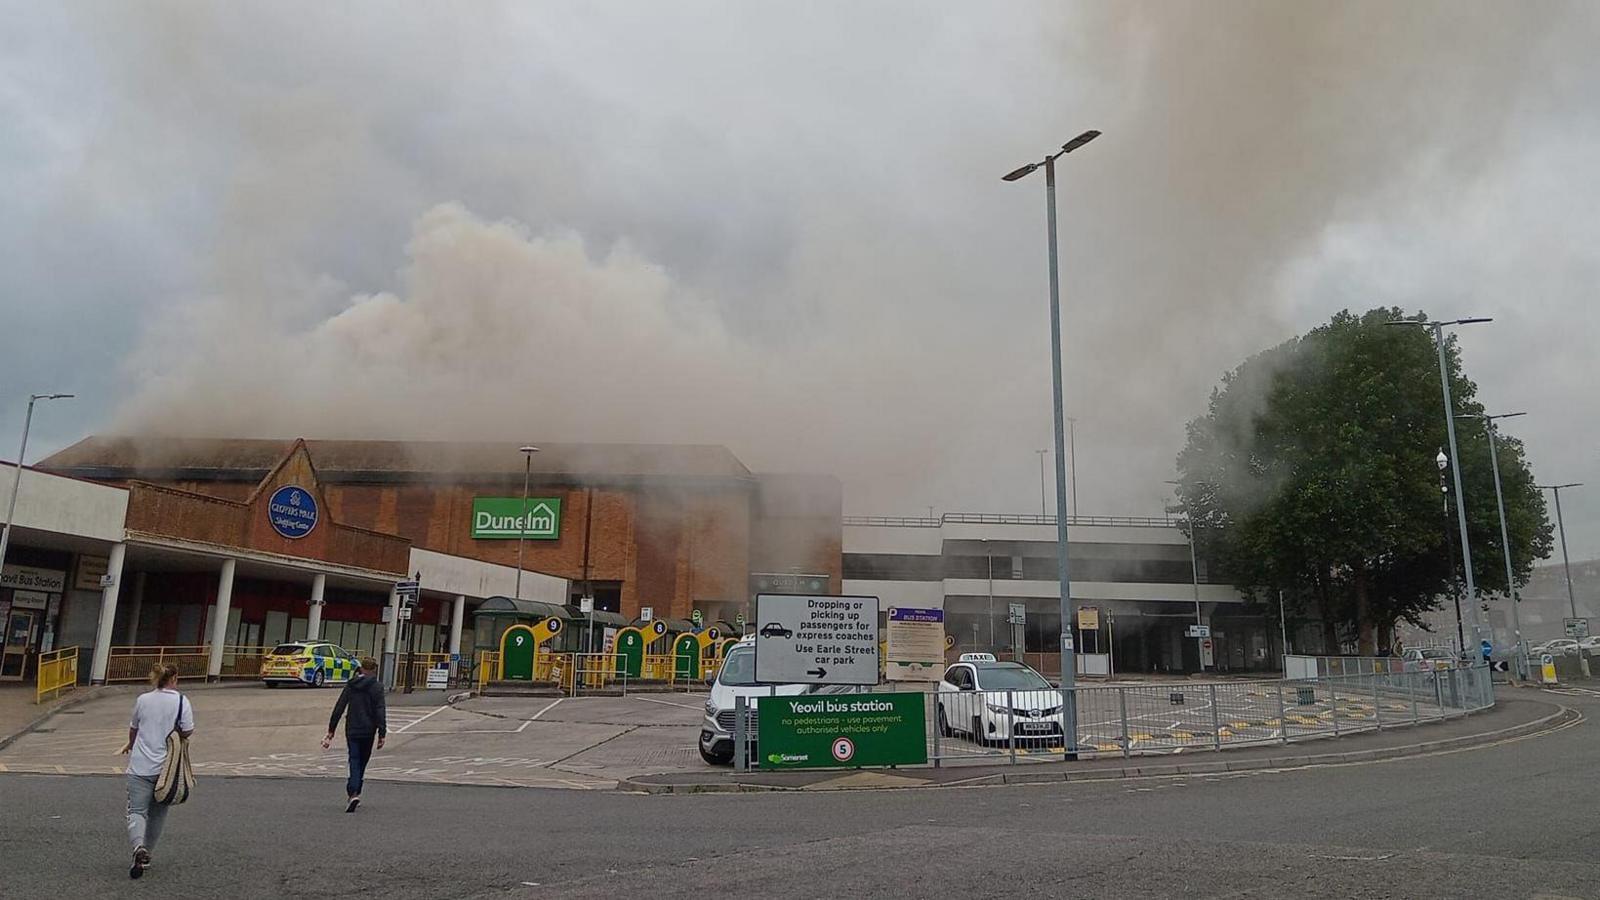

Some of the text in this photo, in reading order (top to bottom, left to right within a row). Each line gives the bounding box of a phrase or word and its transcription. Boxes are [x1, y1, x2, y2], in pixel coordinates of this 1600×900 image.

[476, 511, 550, 530] Dunelm
[19, 574, 33, 585] Bus
[34, 576, 61, 588] Station
[808, 599, 850, 611] Dropping
[811, 610, 859, 621] picking up
[888, 608, 898, 620] P
[550, 620, 557, 630] 9
[657, 624, 663, 632] 8
[800, 621, 869, 631] passengers for
[711, 630, 717, 638] 7
[797, 632, 874, 640] express coaches
[515, 635, 524, 647] 9
[627, 635, 634, 646] 8
[685, 640, 692, 650] 7
[795, 644, 875, 654] Use Earle Street
[833, 655, 855, 665] park
[789, 699, 893, 713] Yeovil bus station
[793, 717, 840, 726] pedestrians
[862, 715, 902, 725] pavement
[796, 724, 889, 734] authorised vehicles only
[839, 744, 847, 754] 5
[781, 753, 808, 762] Somerset
